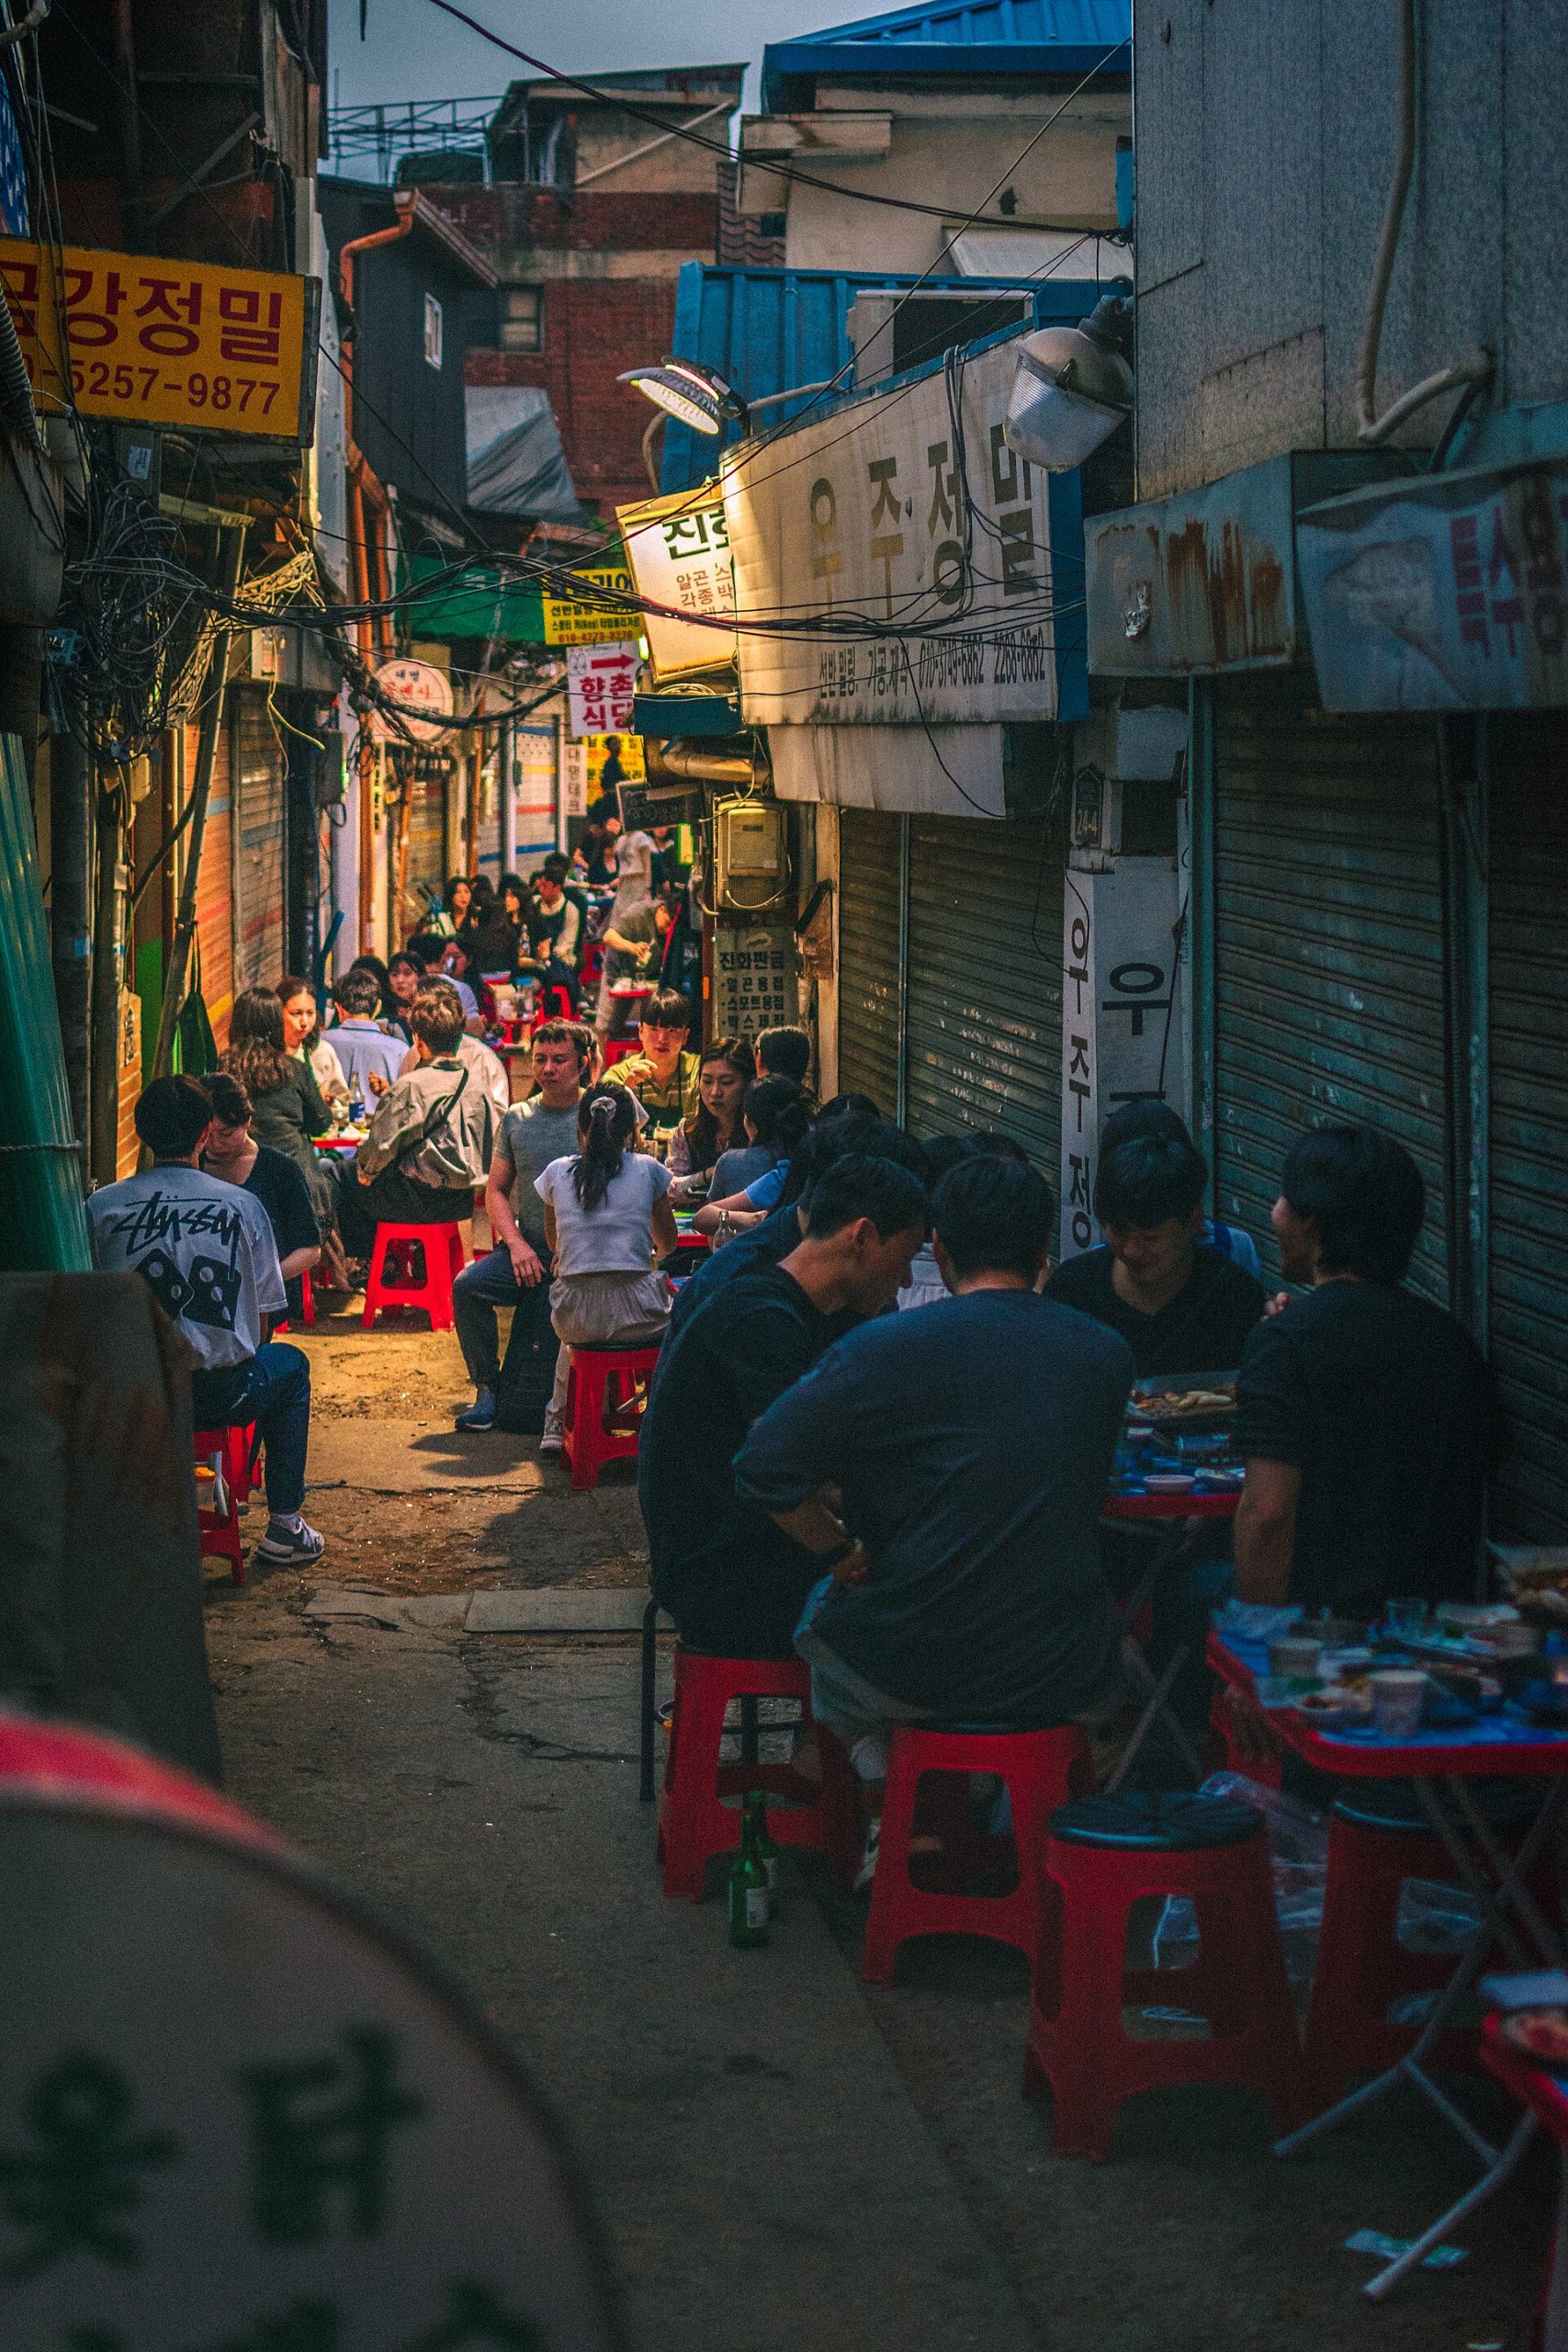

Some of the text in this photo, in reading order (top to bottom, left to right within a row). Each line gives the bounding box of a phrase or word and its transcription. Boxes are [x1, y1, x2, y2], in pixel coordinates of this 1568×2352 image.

[677, 570, 708, 591] 알곤
[681, 588, 714, 607] 각종
[1102, 962, 1173, 1104] 우
